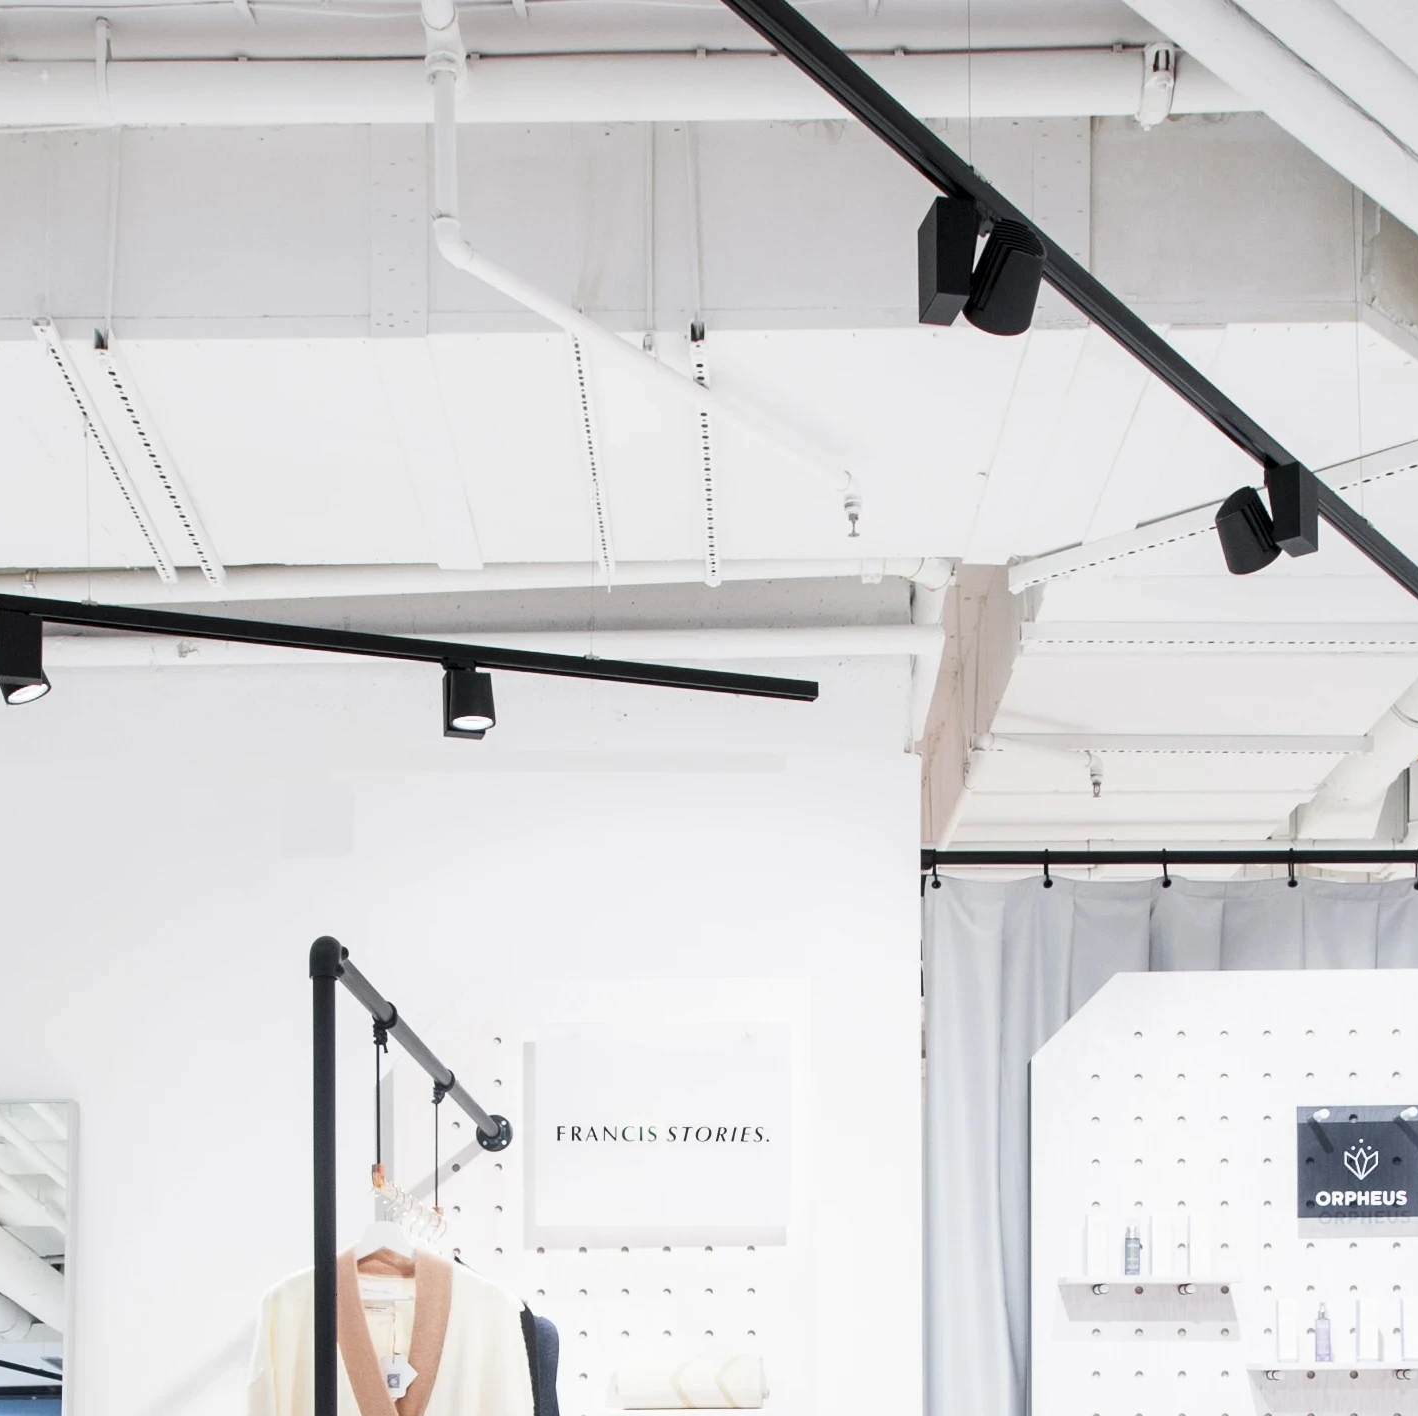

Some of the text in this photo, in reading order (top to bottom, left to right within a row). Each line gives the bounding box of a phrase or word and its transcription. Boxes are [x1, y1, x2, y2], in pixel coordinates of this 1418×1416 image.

[556, 1125, 770, 1142] FRANCIS STORIES.
[1315, 1190, 1408, 1207] ORPHEUS
